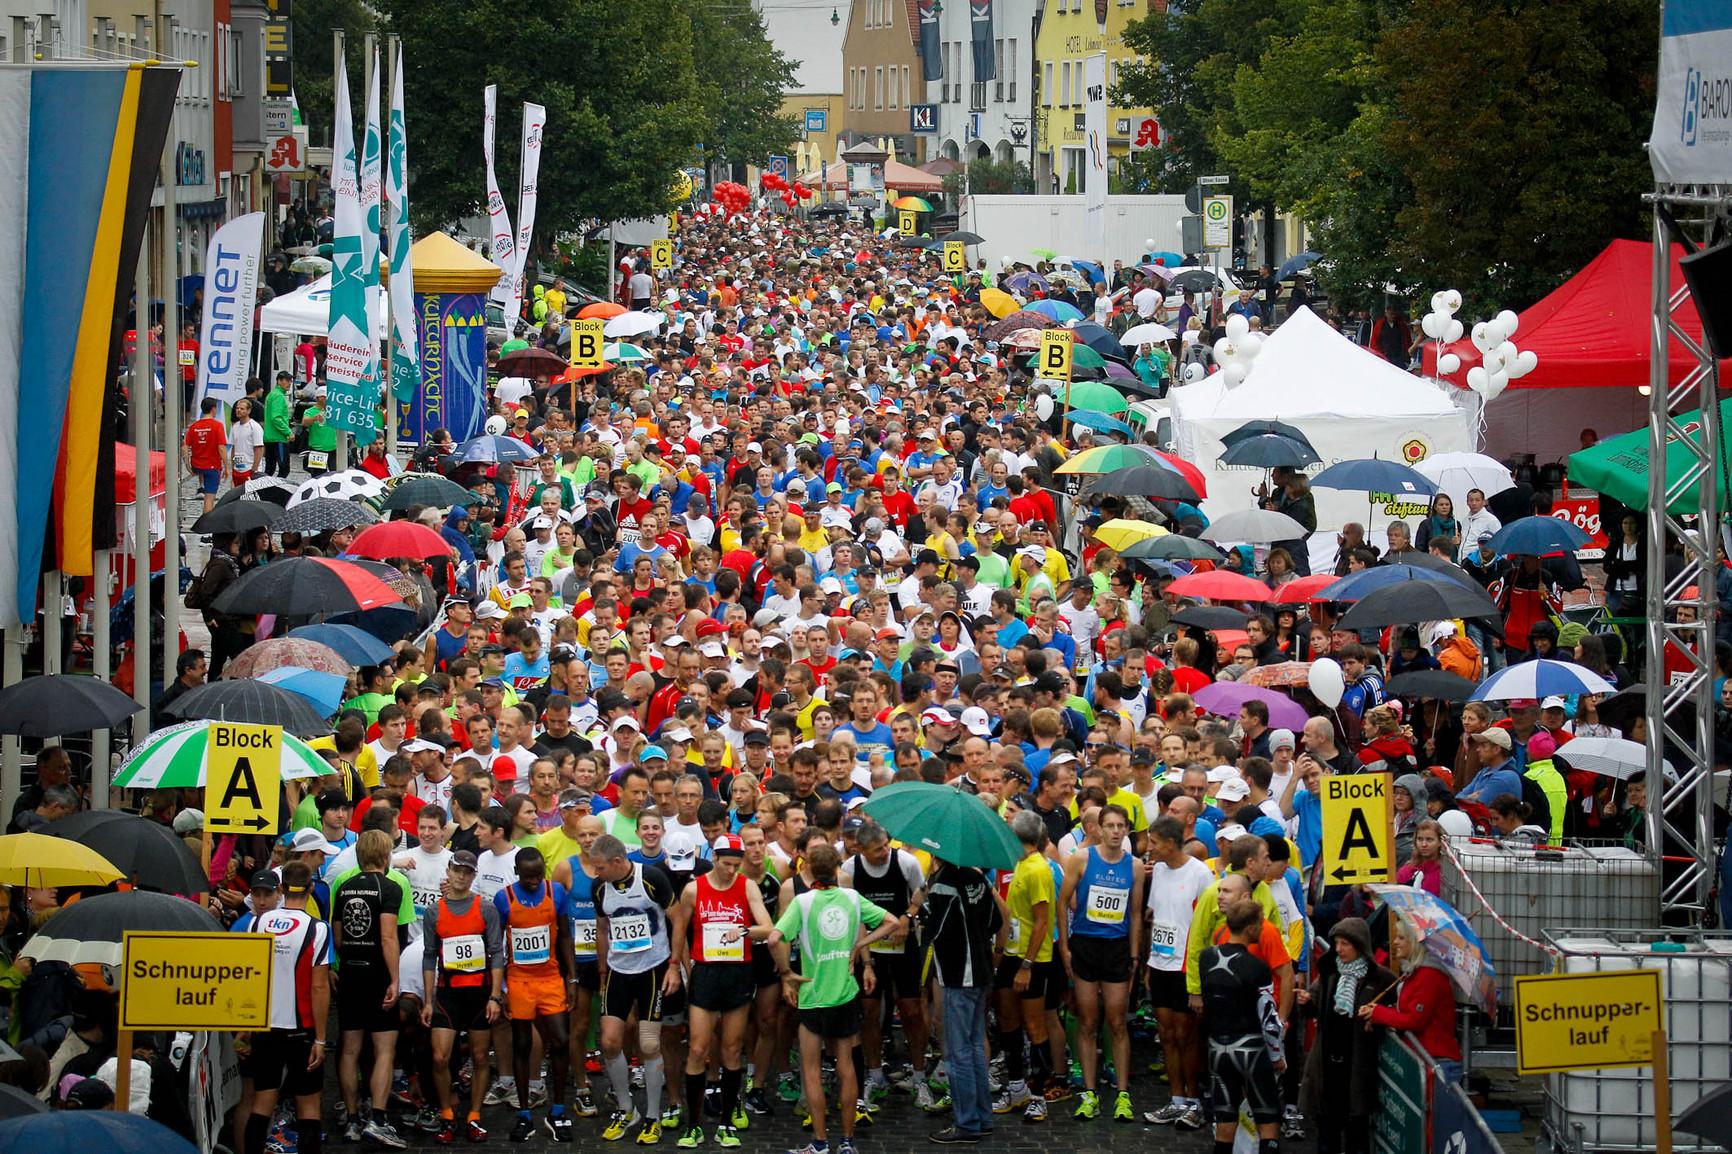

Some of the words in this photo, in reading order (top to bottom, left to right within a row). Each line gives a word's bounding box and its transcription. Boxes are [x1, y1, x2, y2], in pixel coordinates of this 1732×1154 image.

[1066, 36, 1081, 53] HOTEL
[914, 108, 935, 127] KL
[904, 219, 912, 230] D
[657, 248, 666, 262] C
[949, 250, 959, 264] C
[242, 254, 255, 299] further
[240, 305, 251, 345] power
[575, 322, 600, 331] Block
[1045, 332, 1070, 341] Block
[580, 335, 595, 357] B
[1048, 345, 1064, 368] B
[234, 350, 249, 391] Taking
[216, 728, 272, 748] Block
[220, 757, 263, 809] A
[1329, 779, 1384, 799] Block
[1339, 808, 1379, 860] A
[1096, 896, 1120, 910] 500
[268, 918, 290, 930] tkn
[615, 924, 646, 940] 2132
[515, 934, 547, 950] 2001
[1153, 929, 1174, 944] 2676
[456, 945, 472, 959] 98
[133, 960, 261, 983] Schnupper-
[176, 988, 217, 1005] lauf
[1526, 1001, 1651, 1022] Schnupper-
[1570, 1026, 1609, 1046] lauf
